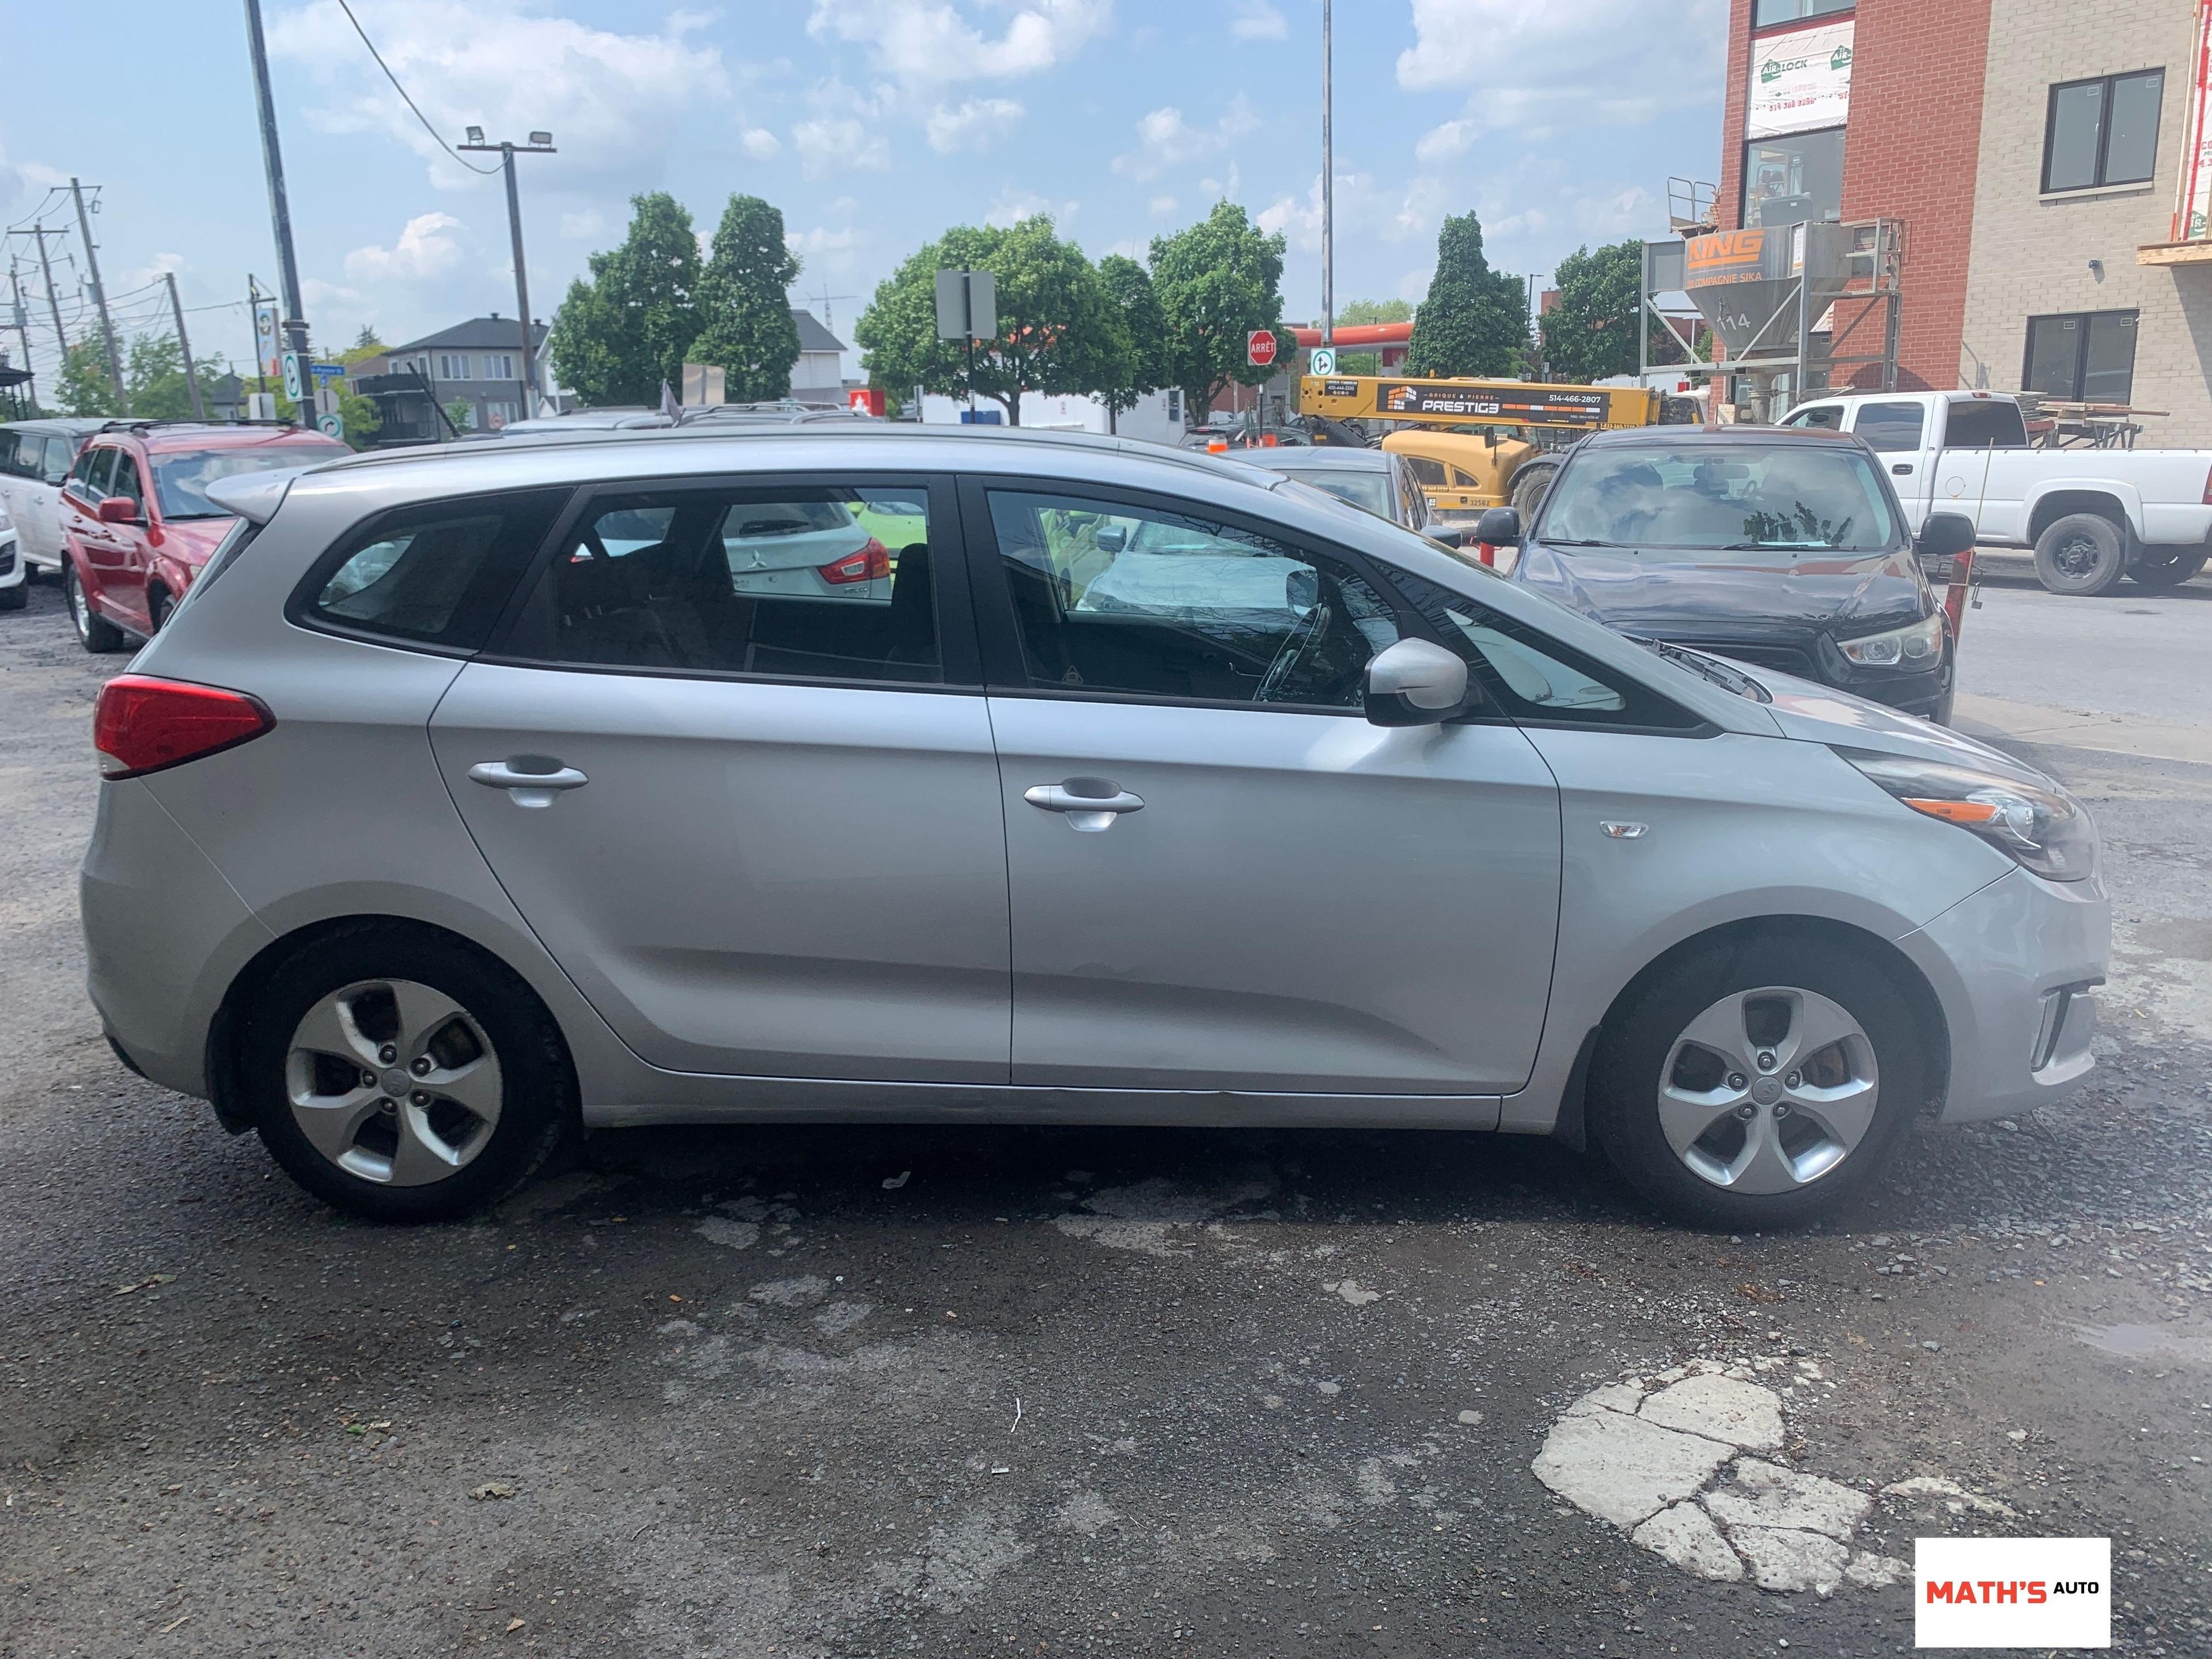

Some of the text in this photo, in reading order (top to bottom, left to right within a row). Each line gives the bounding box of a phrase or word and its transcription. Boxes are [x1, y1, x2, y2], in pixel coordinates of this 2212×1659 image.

[1762, 59, 1808, 75] AIR-LOCK
[1688, 230, 1765, 261] KING
[1695, 274, 1737, 287] COMPAGNIE
[1740, 272, 1762, 282] SIKA
[1251, 341, 1274, 353] ARRÊT
[1548, 395, 1601, 403] 514-466-2807
